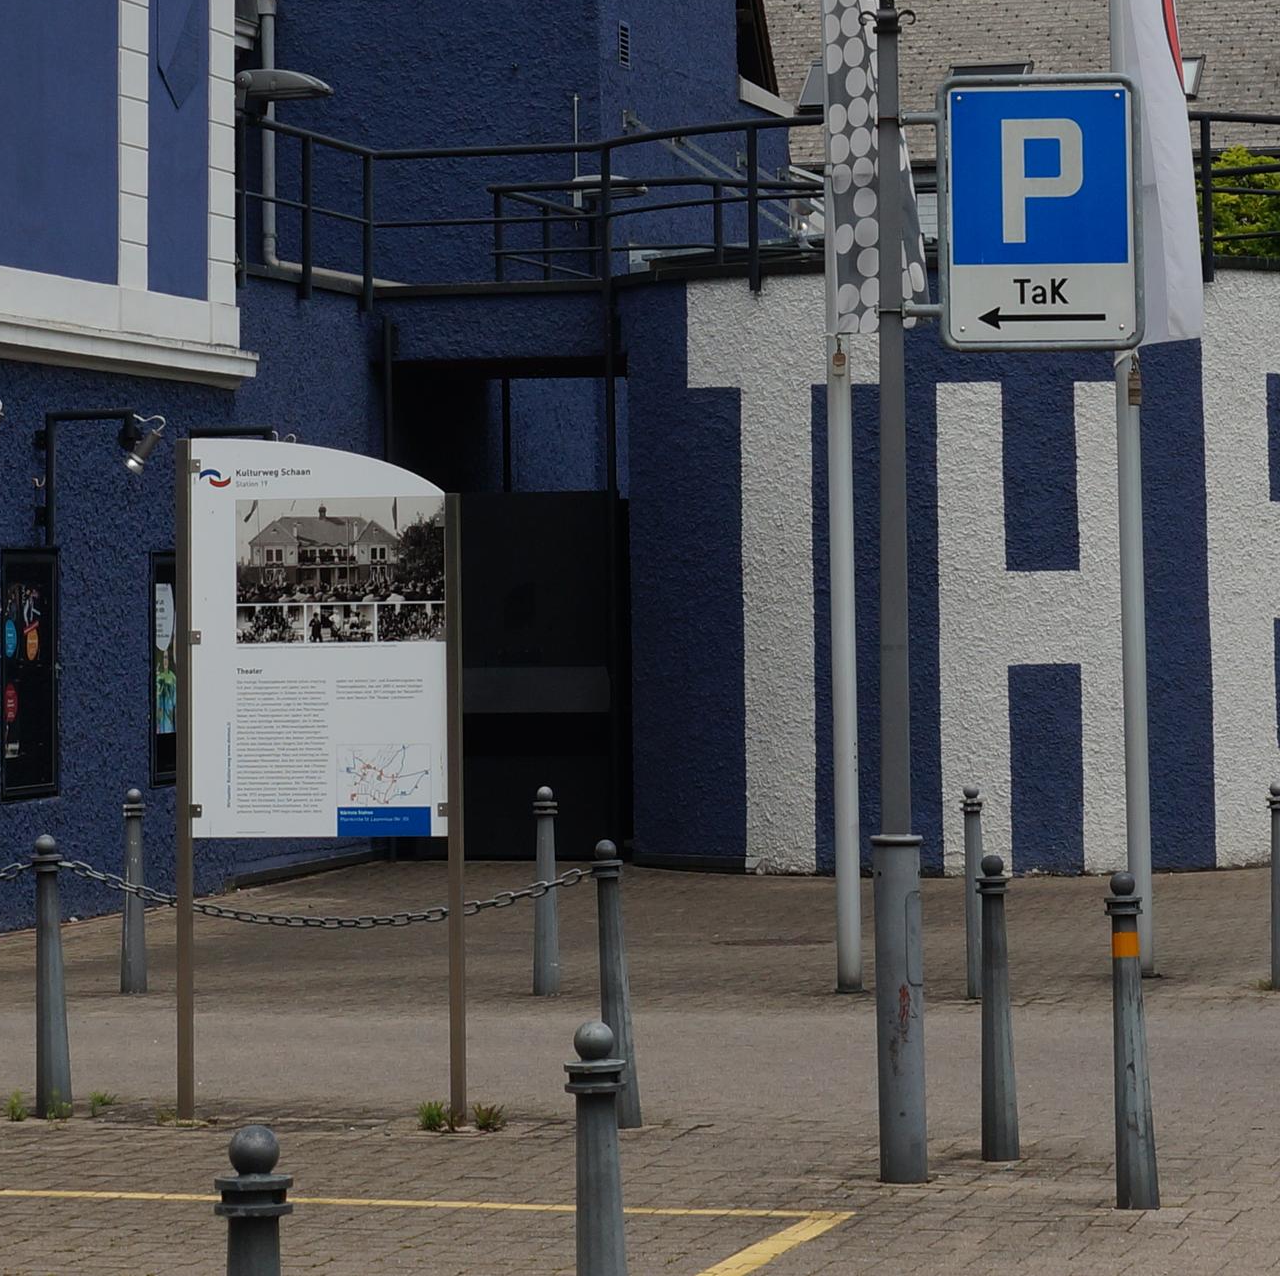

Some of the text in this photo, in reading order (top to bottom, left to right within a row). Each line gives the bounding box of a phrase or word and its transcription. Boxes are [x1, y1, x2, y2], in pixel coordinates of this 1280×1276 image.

[1001, 118, 1084, 244] P
[1013, 278, 1069, 305] TaK
[235, 468, 311, 478] Kulturweg Schaan
[236, 667, 263, 675] Theater
